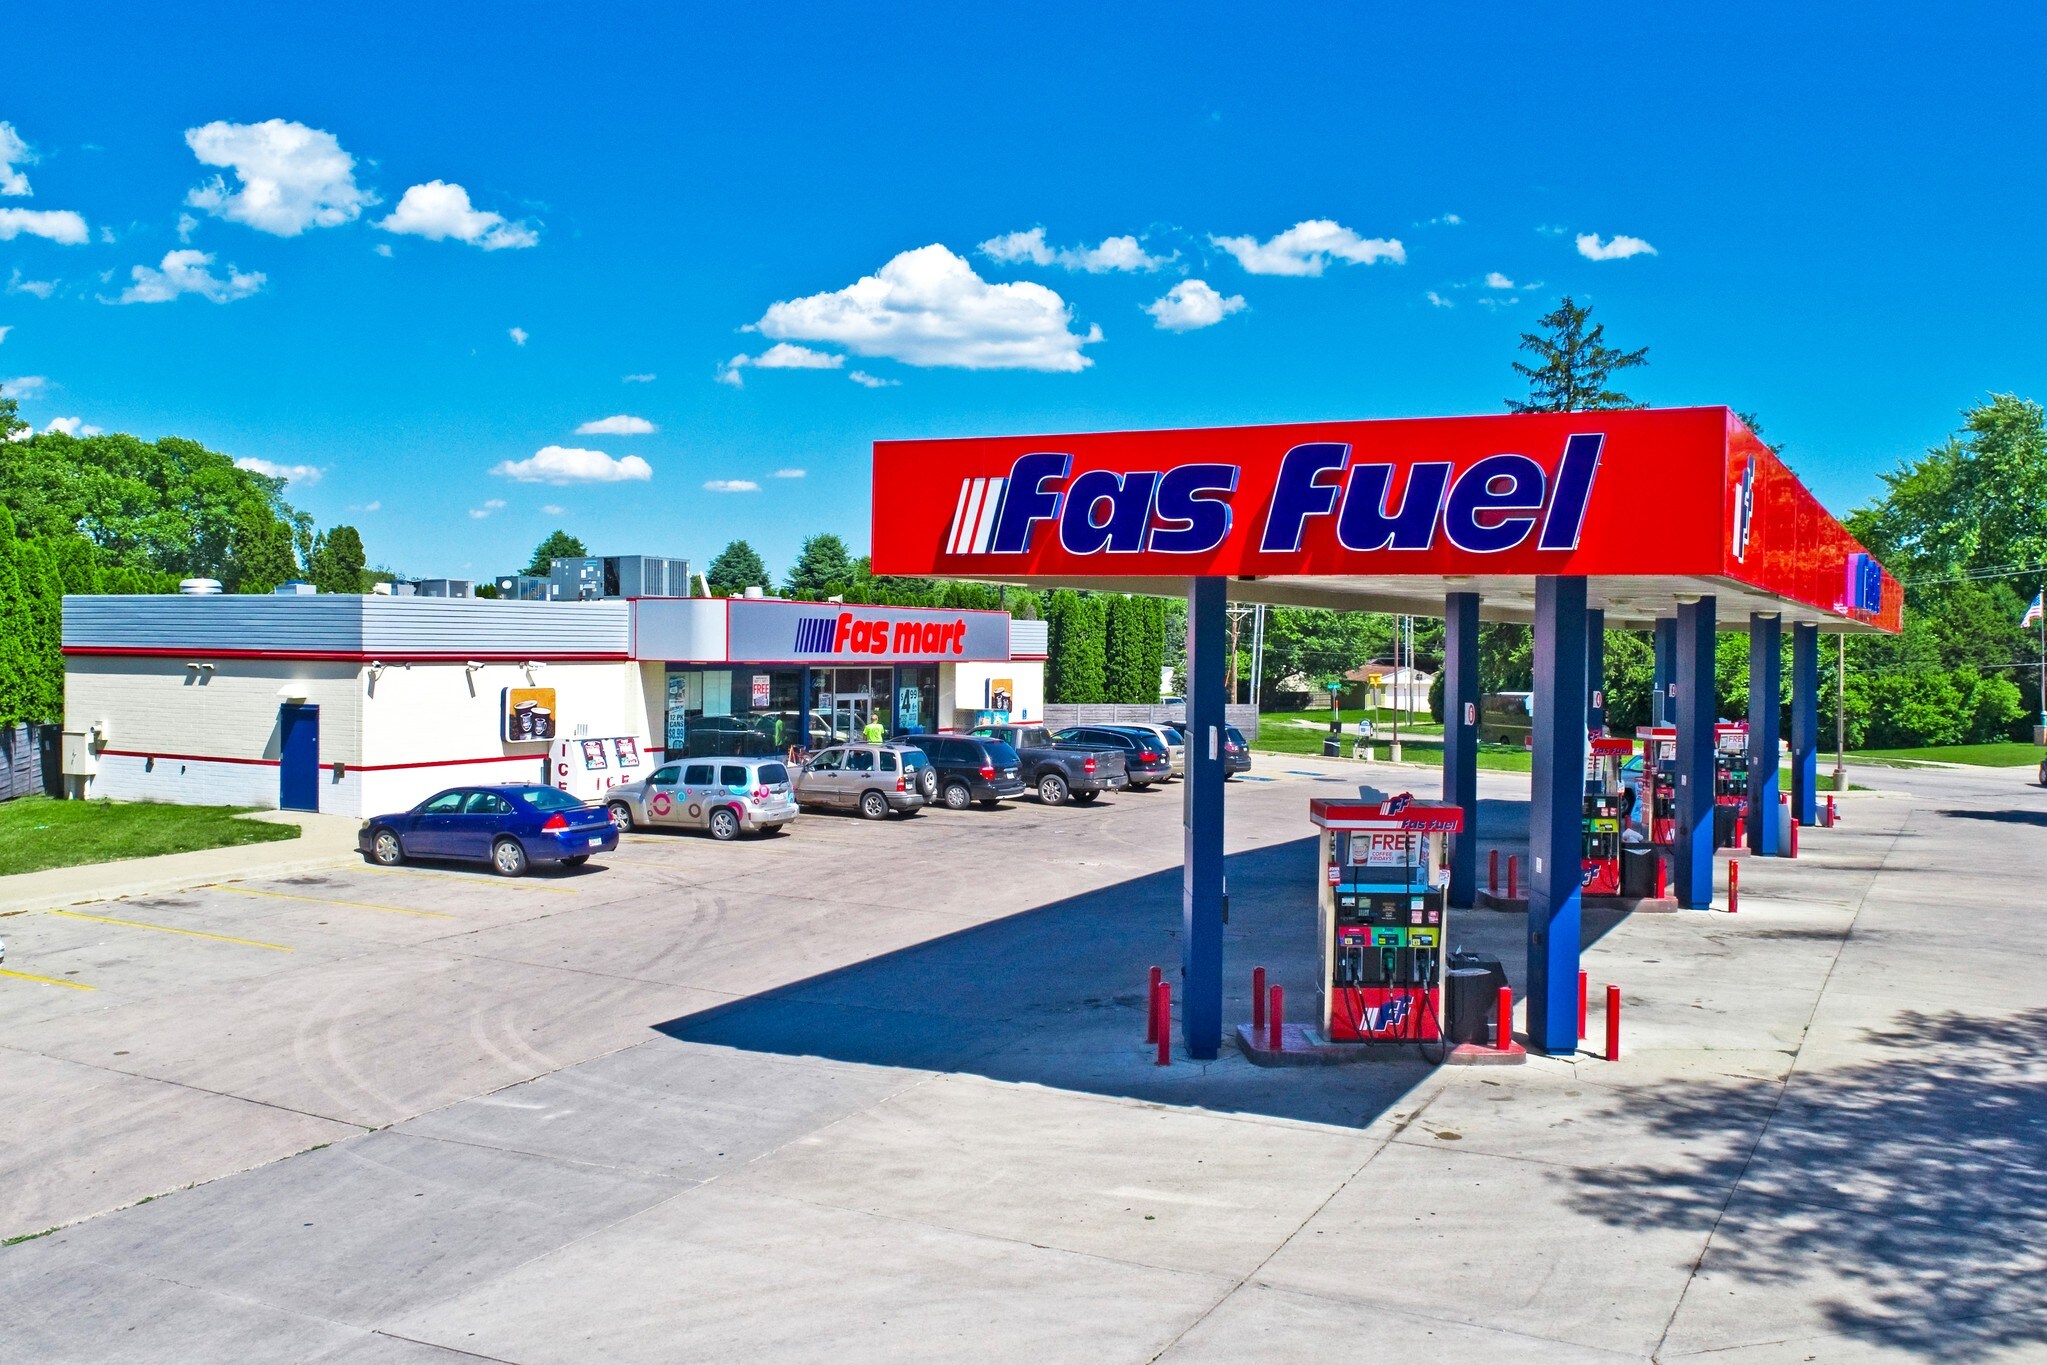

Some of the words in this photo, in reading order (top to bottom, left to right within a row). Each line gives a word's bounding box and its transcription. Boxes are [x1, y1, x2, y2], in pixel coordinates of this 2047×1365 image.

[892, 618, 967, 655] mart
[753, 684, 769, 694] FREE
[1371, 834, 1416, 850] FREE
